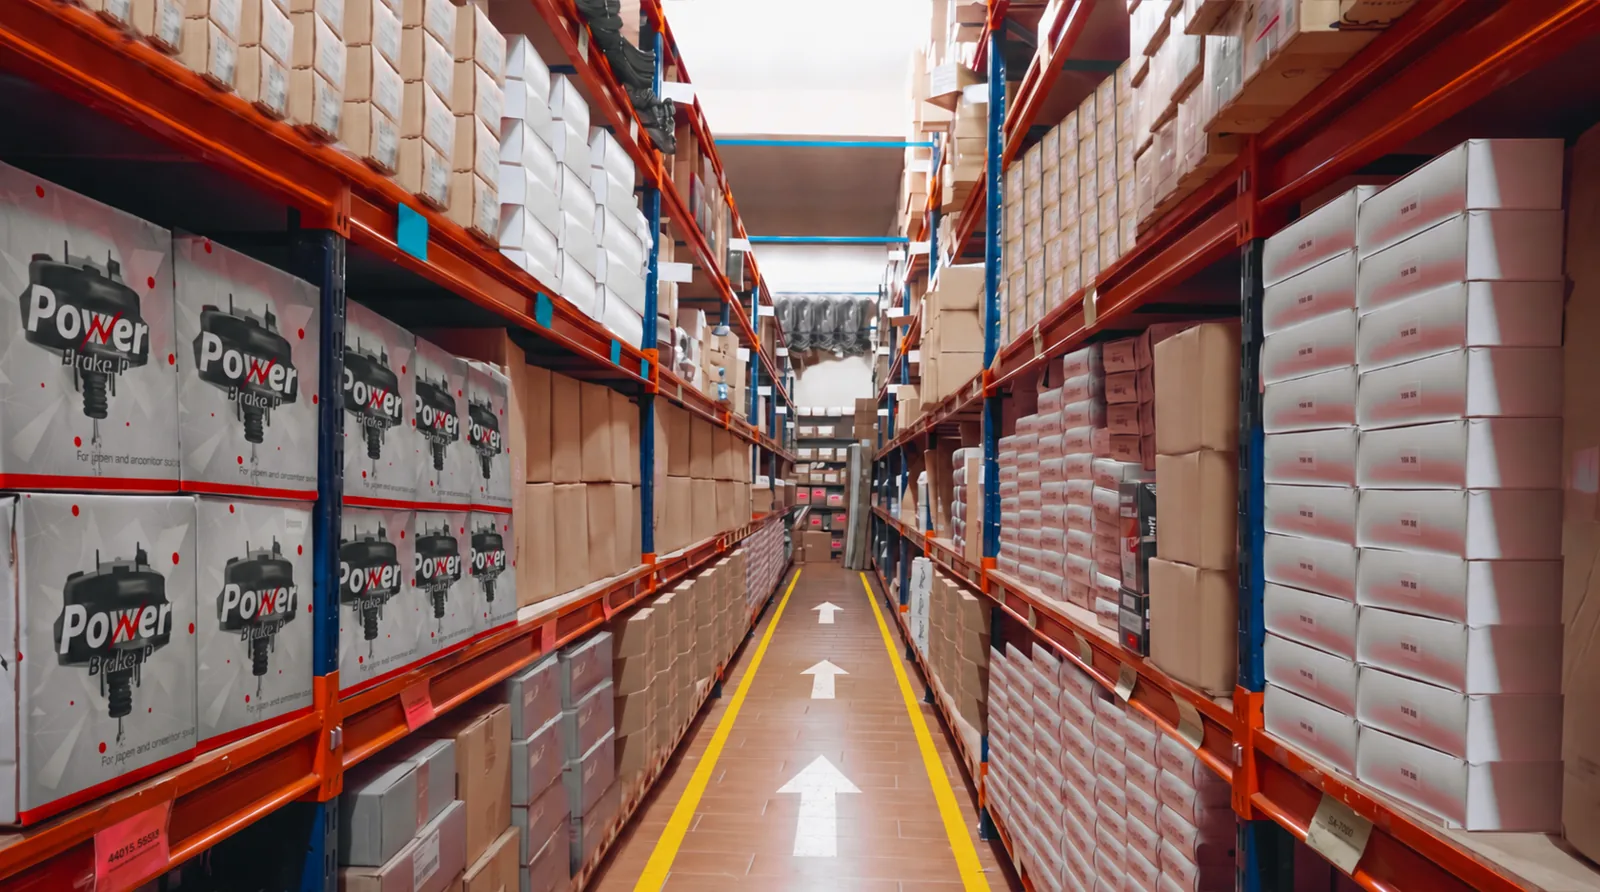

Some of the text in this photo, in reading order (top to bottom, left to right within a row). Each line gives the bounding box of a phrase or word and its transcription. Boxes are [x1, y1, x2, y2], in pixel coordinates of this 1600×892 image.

[27, 284, 149, 355] Power
[62, 349, 113, 373] Brake
[199, 331, 298, 394] Power
[77, 450, 89, 461] For
[115, 453, 130, 465] and
[221, 583, 298, 622] Power
[60, 602, 172, 654] Power
[88, 648, 136, 676] Brake
